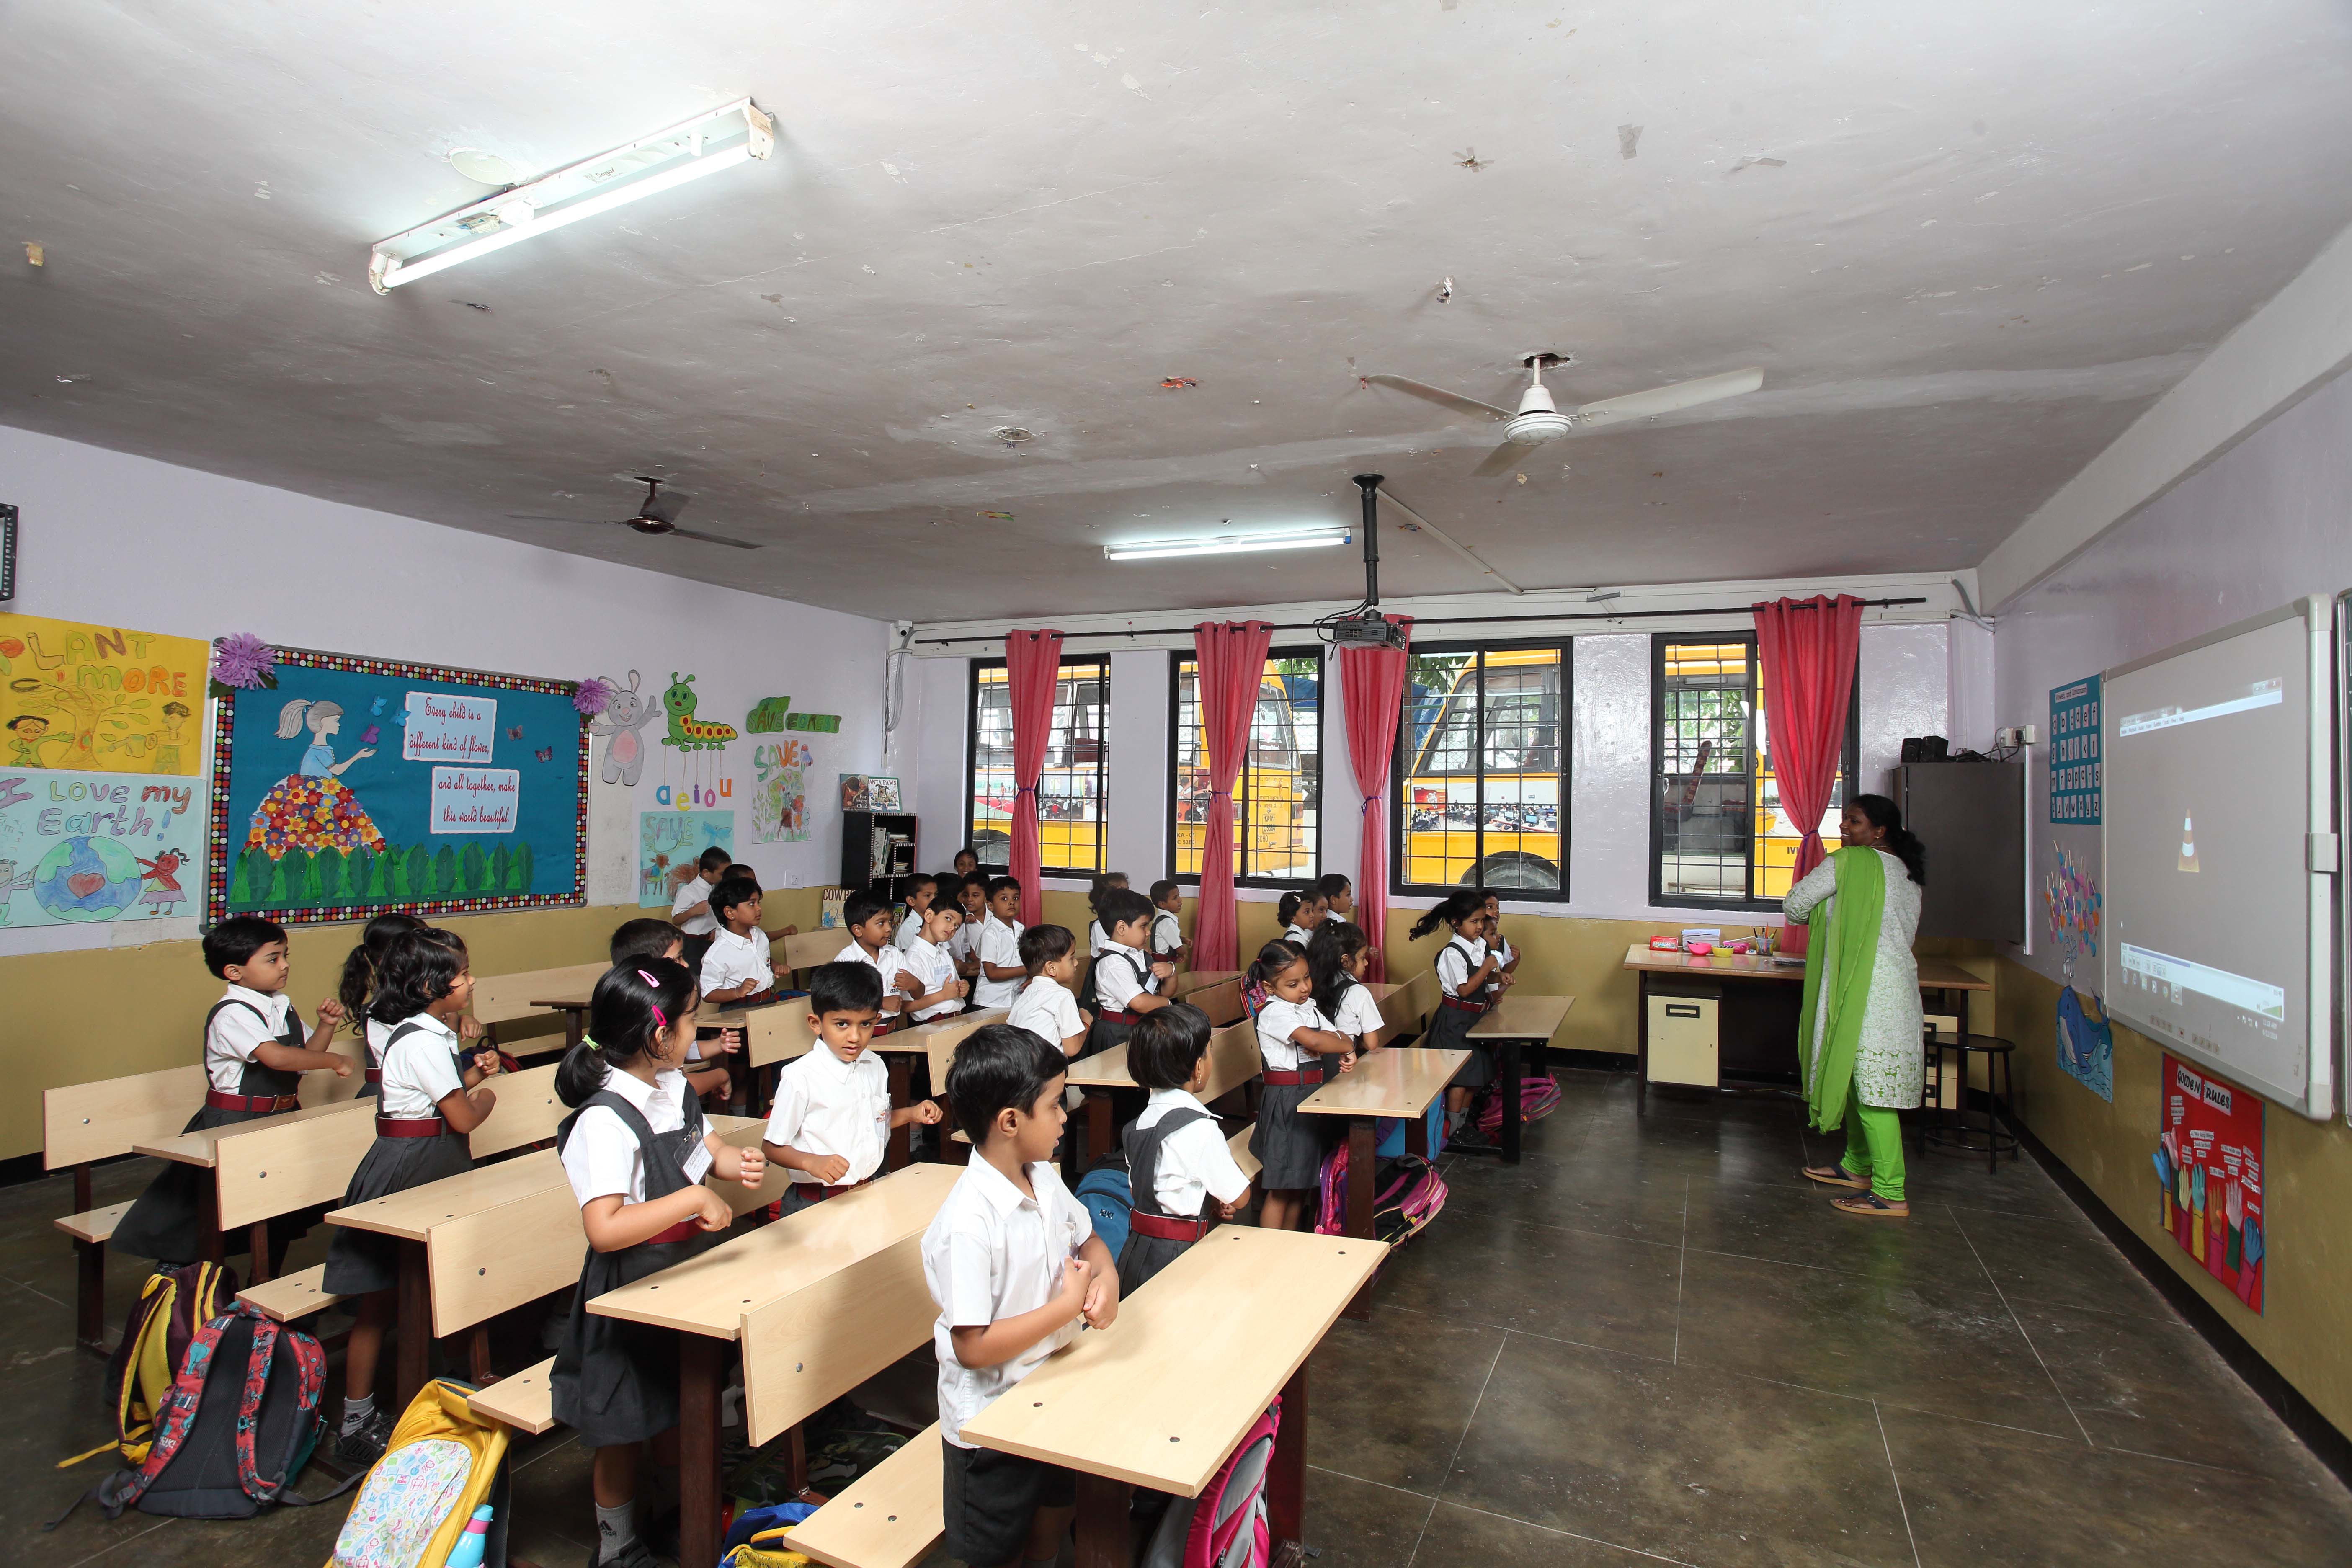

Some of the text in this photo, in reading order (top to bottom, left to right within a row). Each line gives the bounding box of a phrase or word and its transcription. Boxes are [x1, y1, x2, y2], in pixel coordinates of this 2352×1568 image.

[77, 665, 187, 697] MORE
[425, 697, 446, 725] Every
[449, 701, 466, 719] child
[468, 709, 474, 720] is
[747, 709, 784, 732] SAVE
[2061, 714, 2065, 727] b
[2084, 712, 2087, 721] e
[2092, 706, 2096, 720] f
[409, 731, 489, 759] different kind of flower,
[2061, 743, 2065, 757] h
[2083, 740, 2086, 753] k
[754, 740, 799, 782] SAVE
[438, 773, 515, 798] and all together, make
[2061, 775, 2063, 785] n
[2074, 771, 2078, 784] p
[2081, 771, 2085, 784] q
[2095, 771, 2099, 781] s
[141, 785, 192, 814] my
[656, 778, 732, 811] a e i o u
[37, 805, 171, 841] Earth!
[443, 805, 509, 830] this world beautiful.
[643, 816, 694, 842] SAVE
[823, 889, 855, 901] COWB
[2206, 1087, 2230, 1109] RULES
